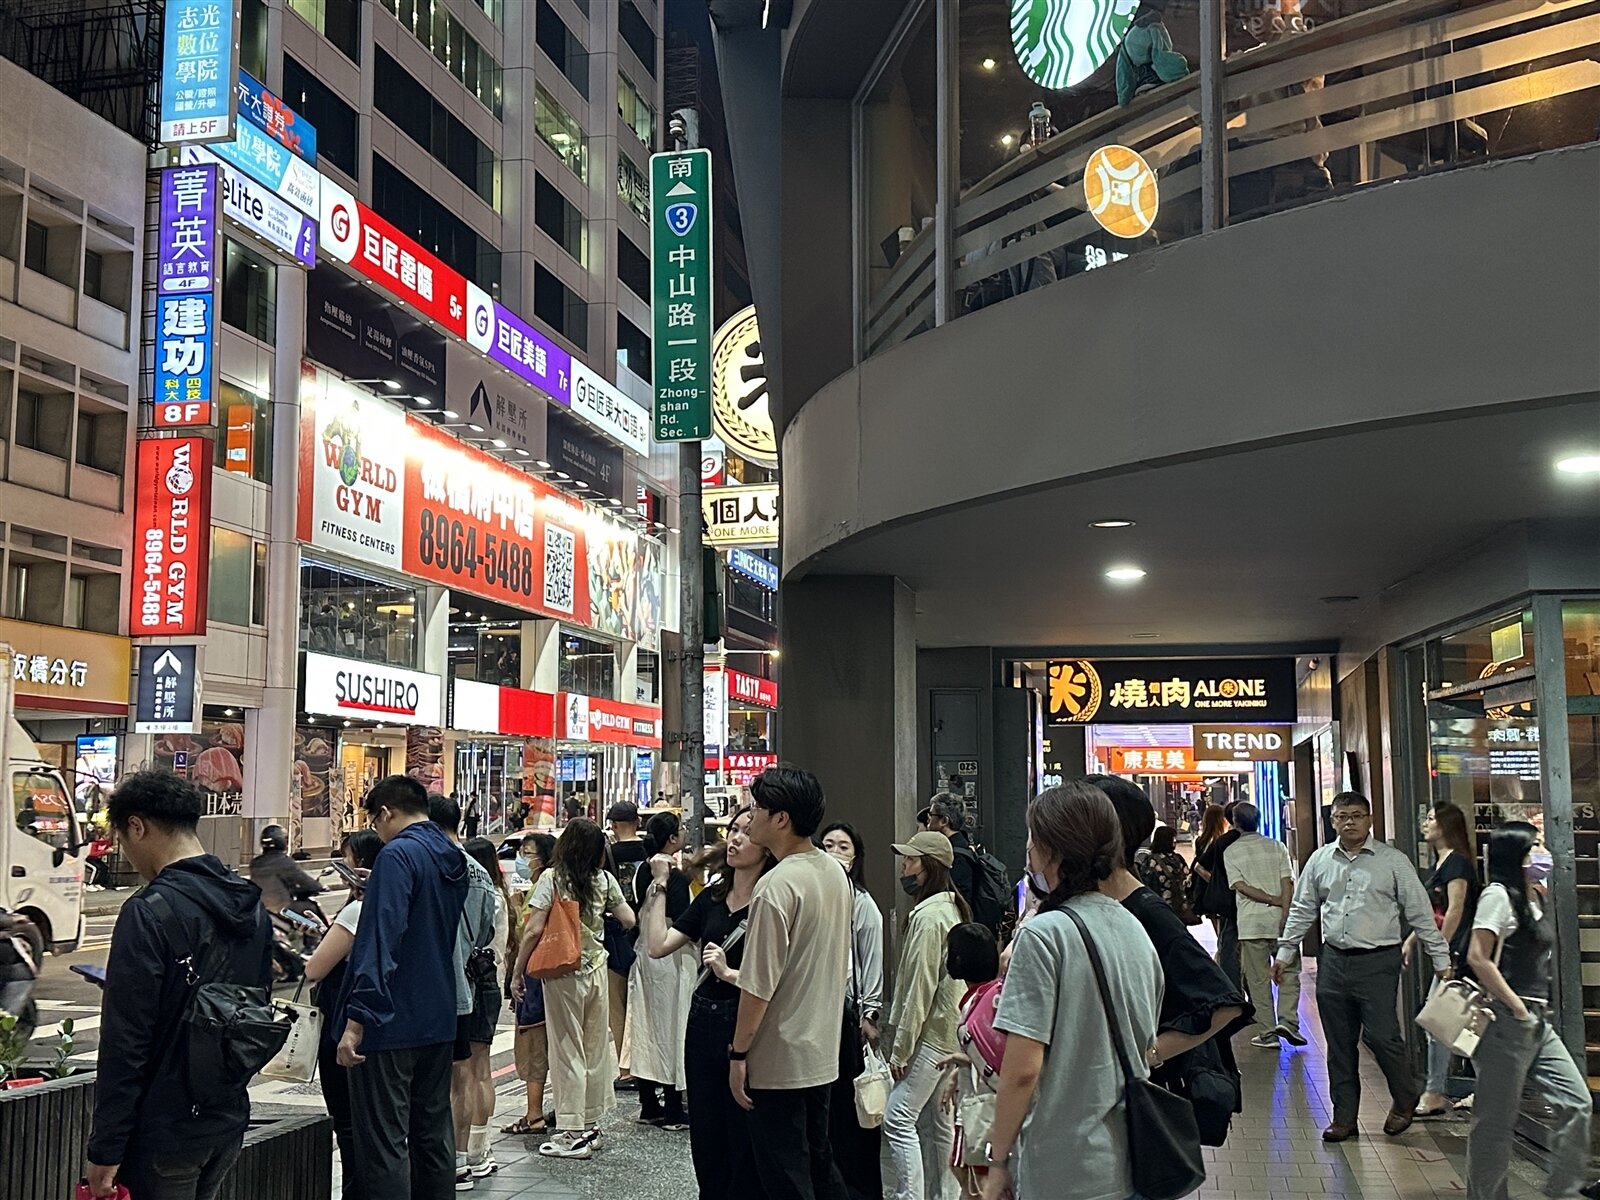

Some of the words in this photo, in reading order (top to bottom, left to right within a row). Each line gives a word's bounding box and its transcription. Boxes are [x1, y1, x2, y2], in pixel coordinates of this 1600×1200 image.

[178, 5, 220, 28] 志光
[177, 31, 219, 57] 數位
[176, 58, 218, 84] 學院
[238, 82, 286, 132] 元大證券
[173, 119, 217, 137] 請上5F
[667, 157, 693, 179] 南
[171, 170, 208, 260] 菁英
[675, 208, 688, 229] 3
[303, 226, 312, 257] 4F
[163, 260, 210, 275] 語言教育
[363, 223, 433, 302] 巨匠電腦
[178, 279, 196, 288] 4F
[449, 294, 463, 321] 5F
[667, 244, 697, 382] 中山路一段
[162, 298, 208, 376] 建功
[497, 317, 548, 379] 巨匠美語
[558, 369, 568, 391] 7F
[660, 387, 706, 400] Zhong-
[164, 403, 202, 422] 8F
[587, 382, 638, 439] 巨匠東大日語
[660, 401, 689, 411] shan
[660, 414, 680, 424] Rd.
[660, 427, 687, 437] Sec.
[693, 426, 699, 436] 1
[600, 463, 611, 483] 4F
[336, 484, 382, 524] GYM
[321, 520, 358, 542] FITNESS
[359, 534, 396, 555] CENTERS
[714, 526, 736, 538] ONE
[740, 525, 770, 536] MORE
[420, 508, 532, 597] 8964-5488
[142, 528, 164, 626] 8964-5488
[166, 561, 187, 626] GYM
[335, 670, 419, 711] SUSHIRO
[735, 673, 760, 698] TASTY
[1194, 700, 1210, 708] ONE
[1211, 700, 1233, 708] MORE
[633, 721, 654, 735] FITNESS
[1201, 732, 1282, 750] TREND
[728, 755, 768, 768] TASTY
[1124, 750, 1185, 769] 康是美
